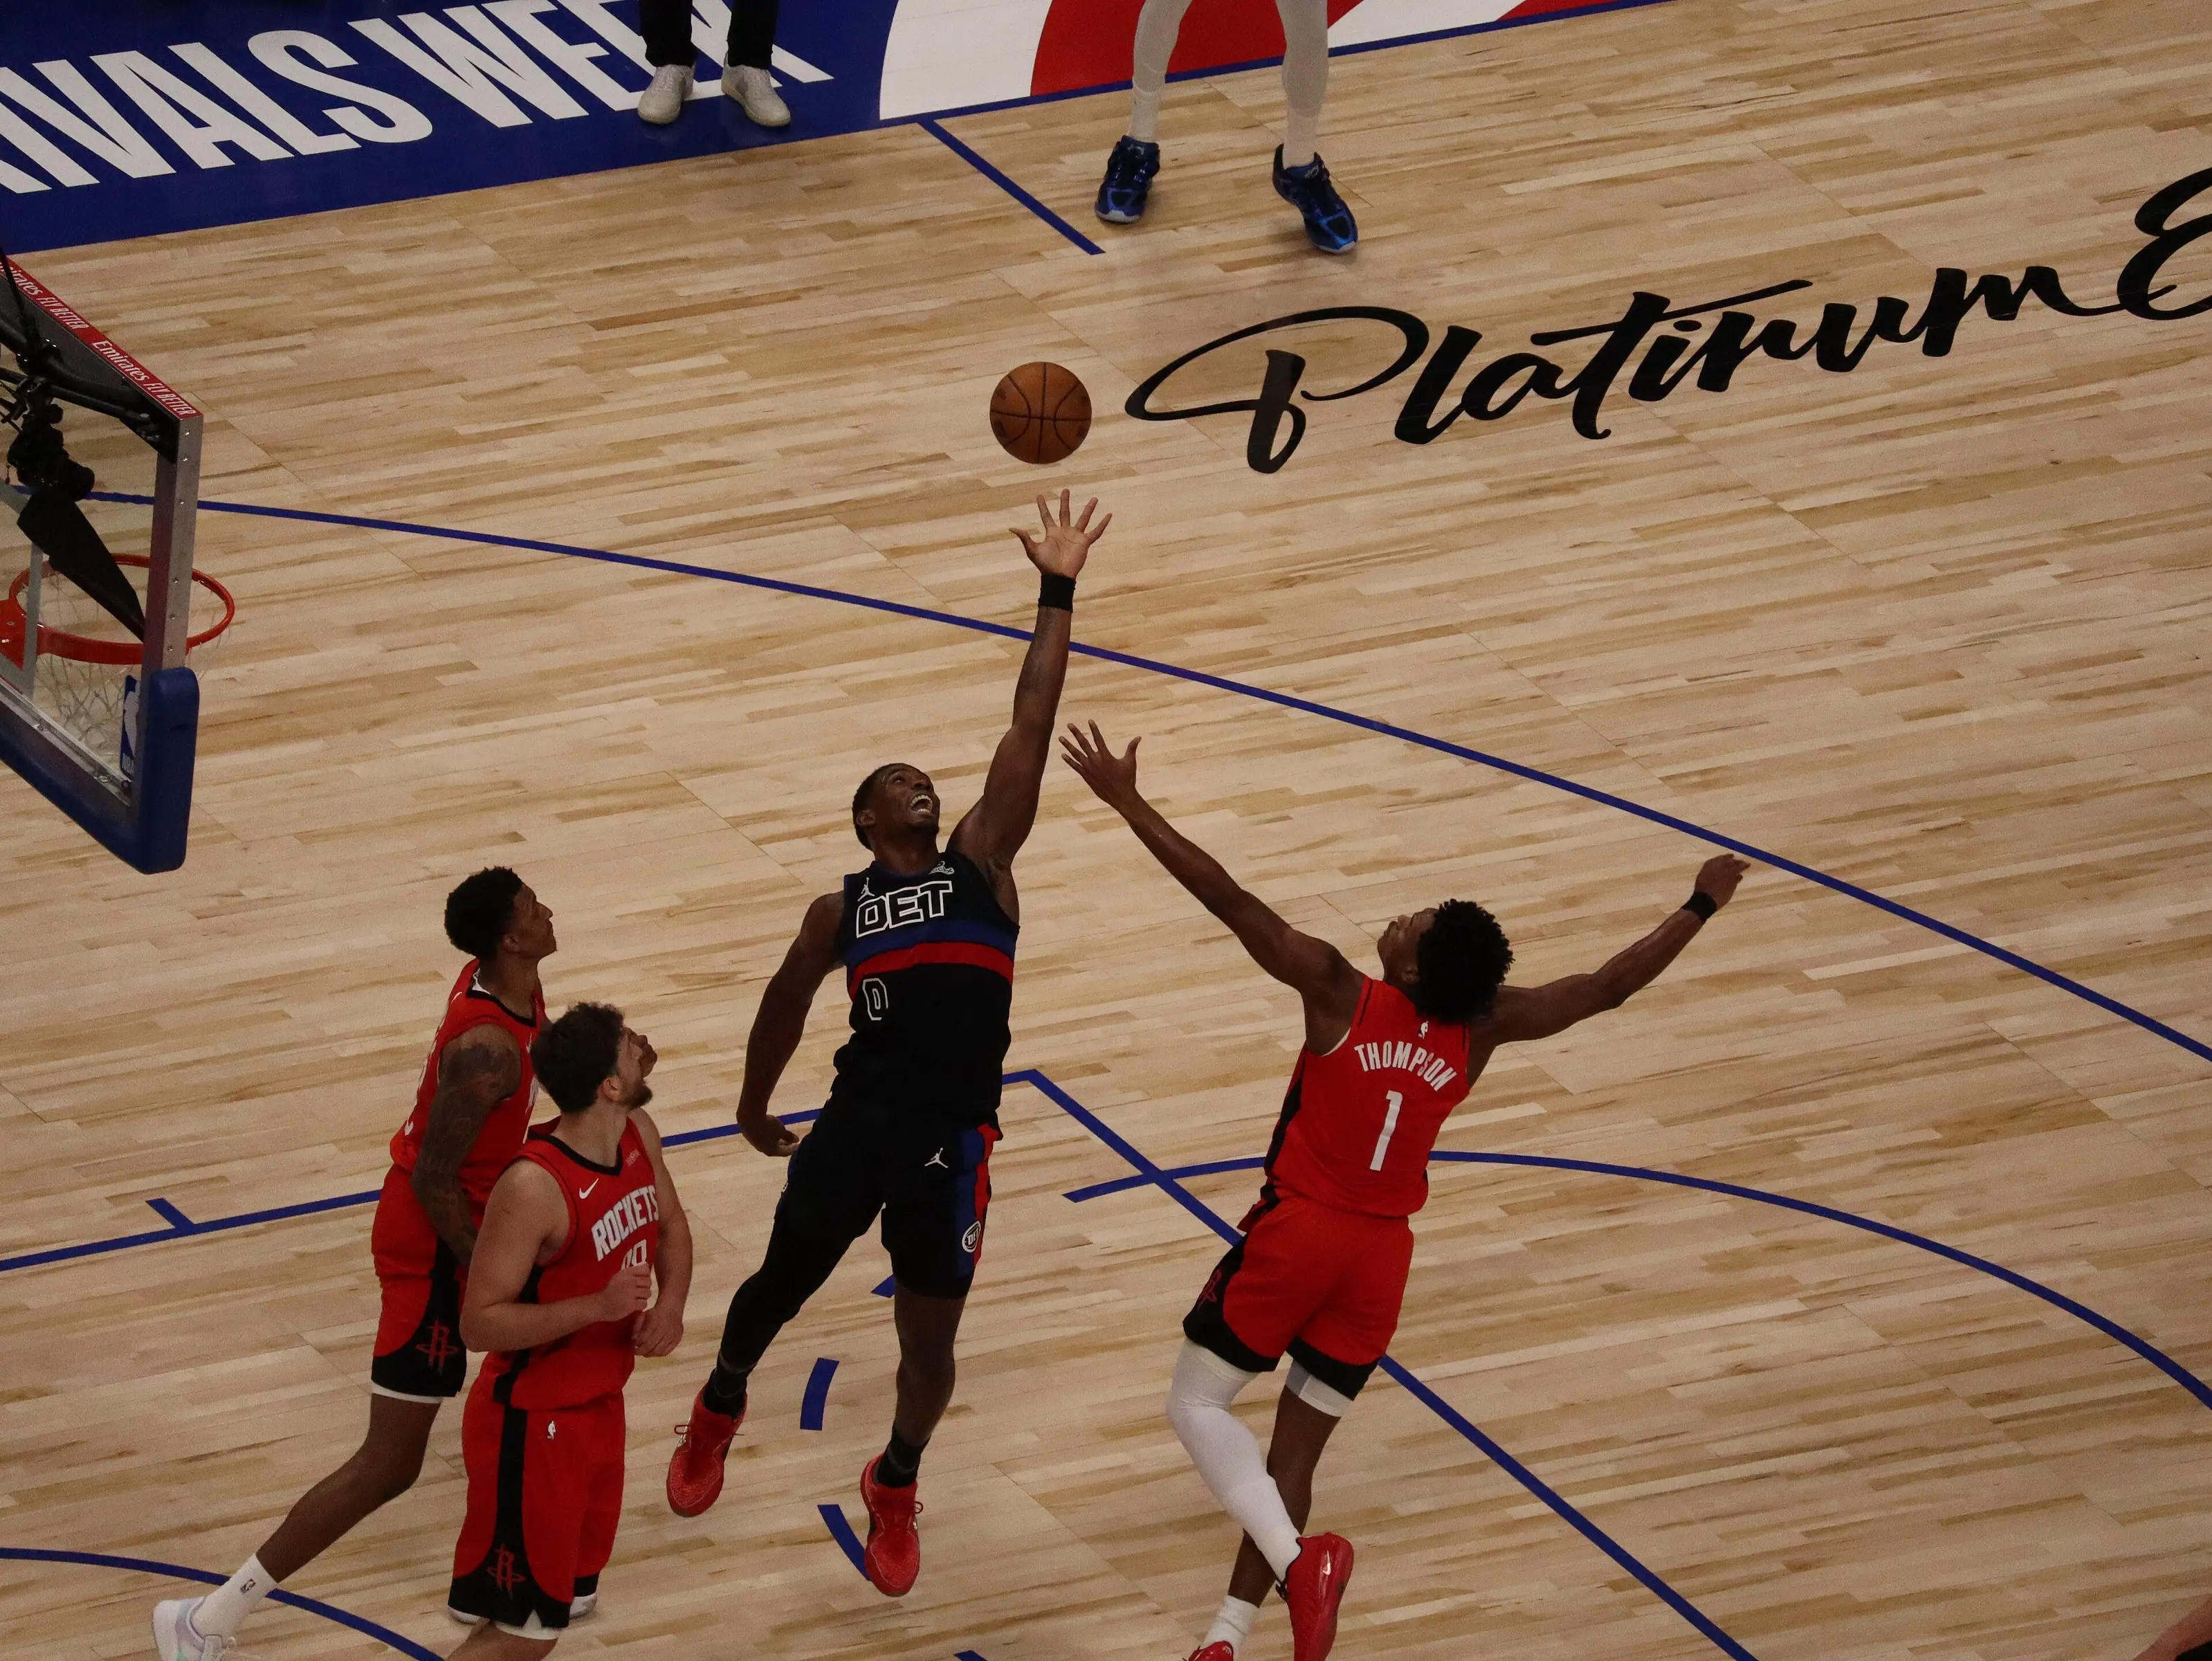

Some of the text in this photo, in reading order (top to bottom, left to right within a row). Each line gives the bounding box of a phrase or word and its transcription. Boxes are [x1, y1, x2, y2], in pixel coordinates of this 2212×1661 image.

[0, 30, 433, 194] IVALS
[36, 297, 64, 307] FLY
[50, 308, 89, 329] BETTER
[91, 340, 150, 381] Emirates
[1124, 266, 2121, 474] Platinum
[143, 383, 170, 393] FLY
[156, 393, 197, 416] BETTER
[855, 880, 953, 939] DET
[862, 977, 889, 1021] 0
[1353, 1040, 1458, 1092] THOMPSON
[1369, 1089, 1403, 1172] 1
[590, 1185, 659, 1262] ROCKETS
